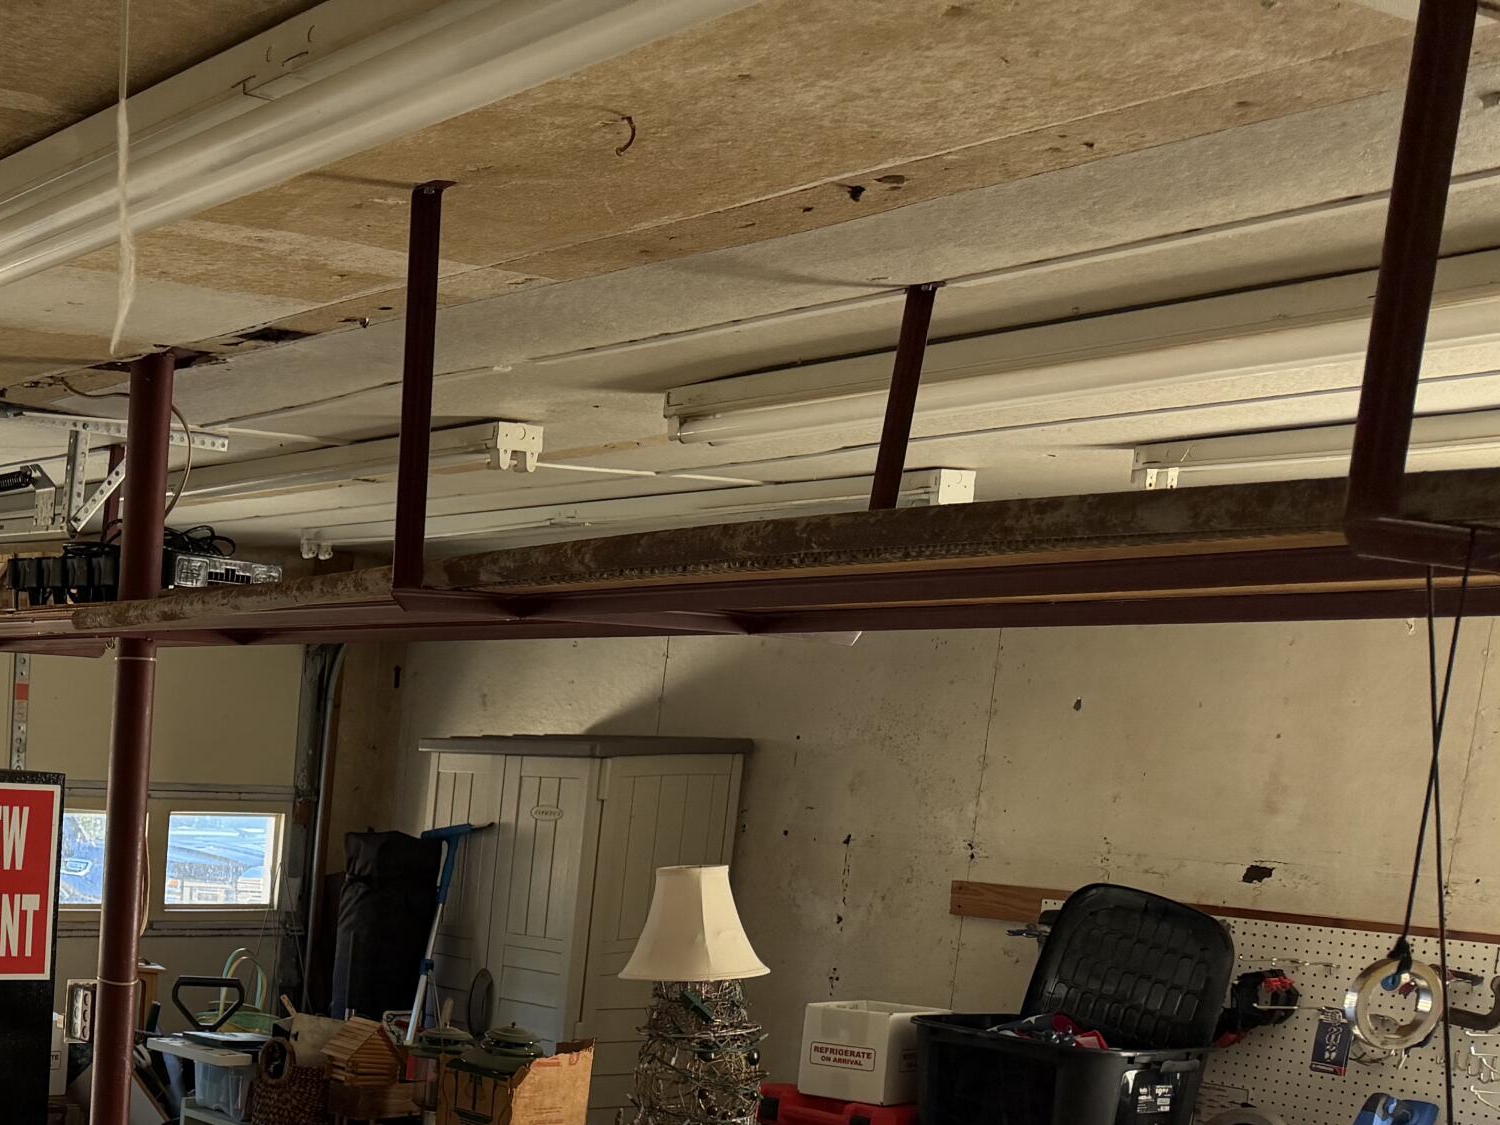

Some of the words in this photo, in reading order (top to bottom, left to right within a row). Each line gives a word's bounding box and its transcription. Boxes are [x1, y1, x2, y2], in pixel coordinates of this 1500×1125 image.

[813, 1045, 873, 1060] REFRIGERATE
[820, 1055, 832, 1063] ON
[832, 1057, 863, 1067] ARRIVAL
